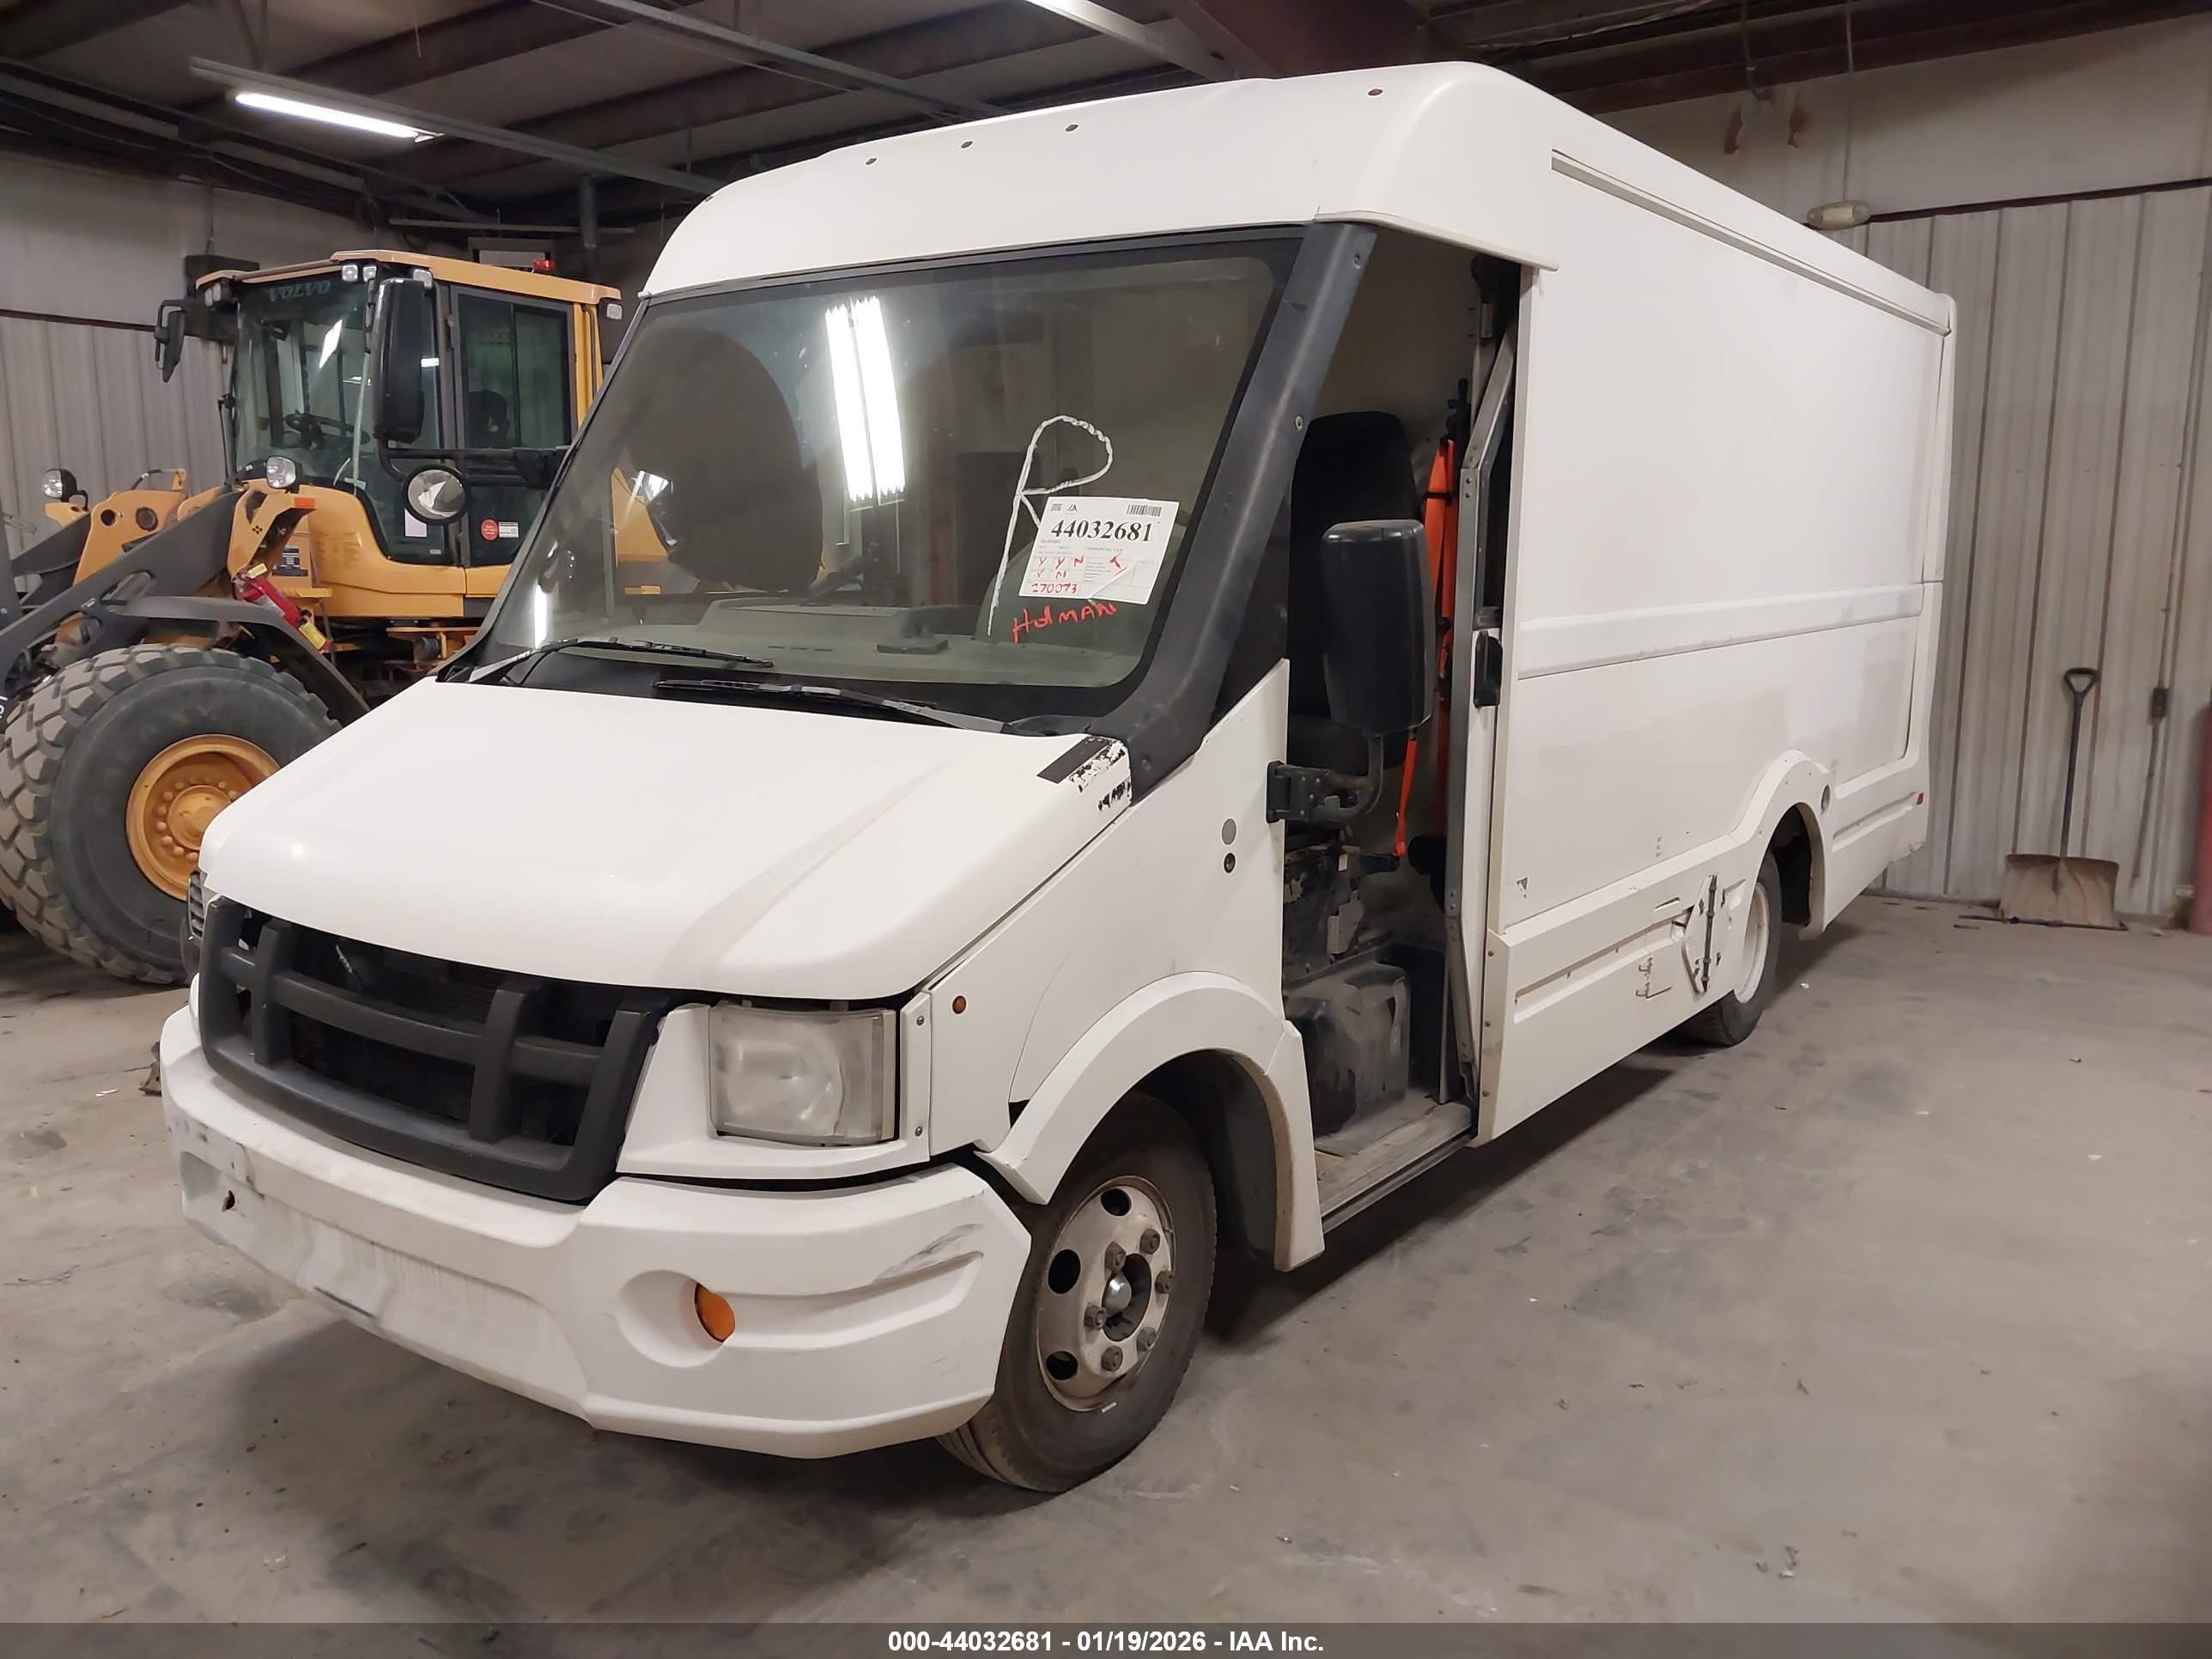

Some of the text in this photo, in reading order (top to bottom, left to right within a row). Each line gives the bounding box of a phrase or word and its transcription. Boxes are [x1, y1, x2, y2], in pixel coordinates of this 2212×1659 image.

[264, 280, 331, 302] VOLVO
[1050, 520, 1152, 542] 44032681
[1054, 556, 1066, 569] Y
